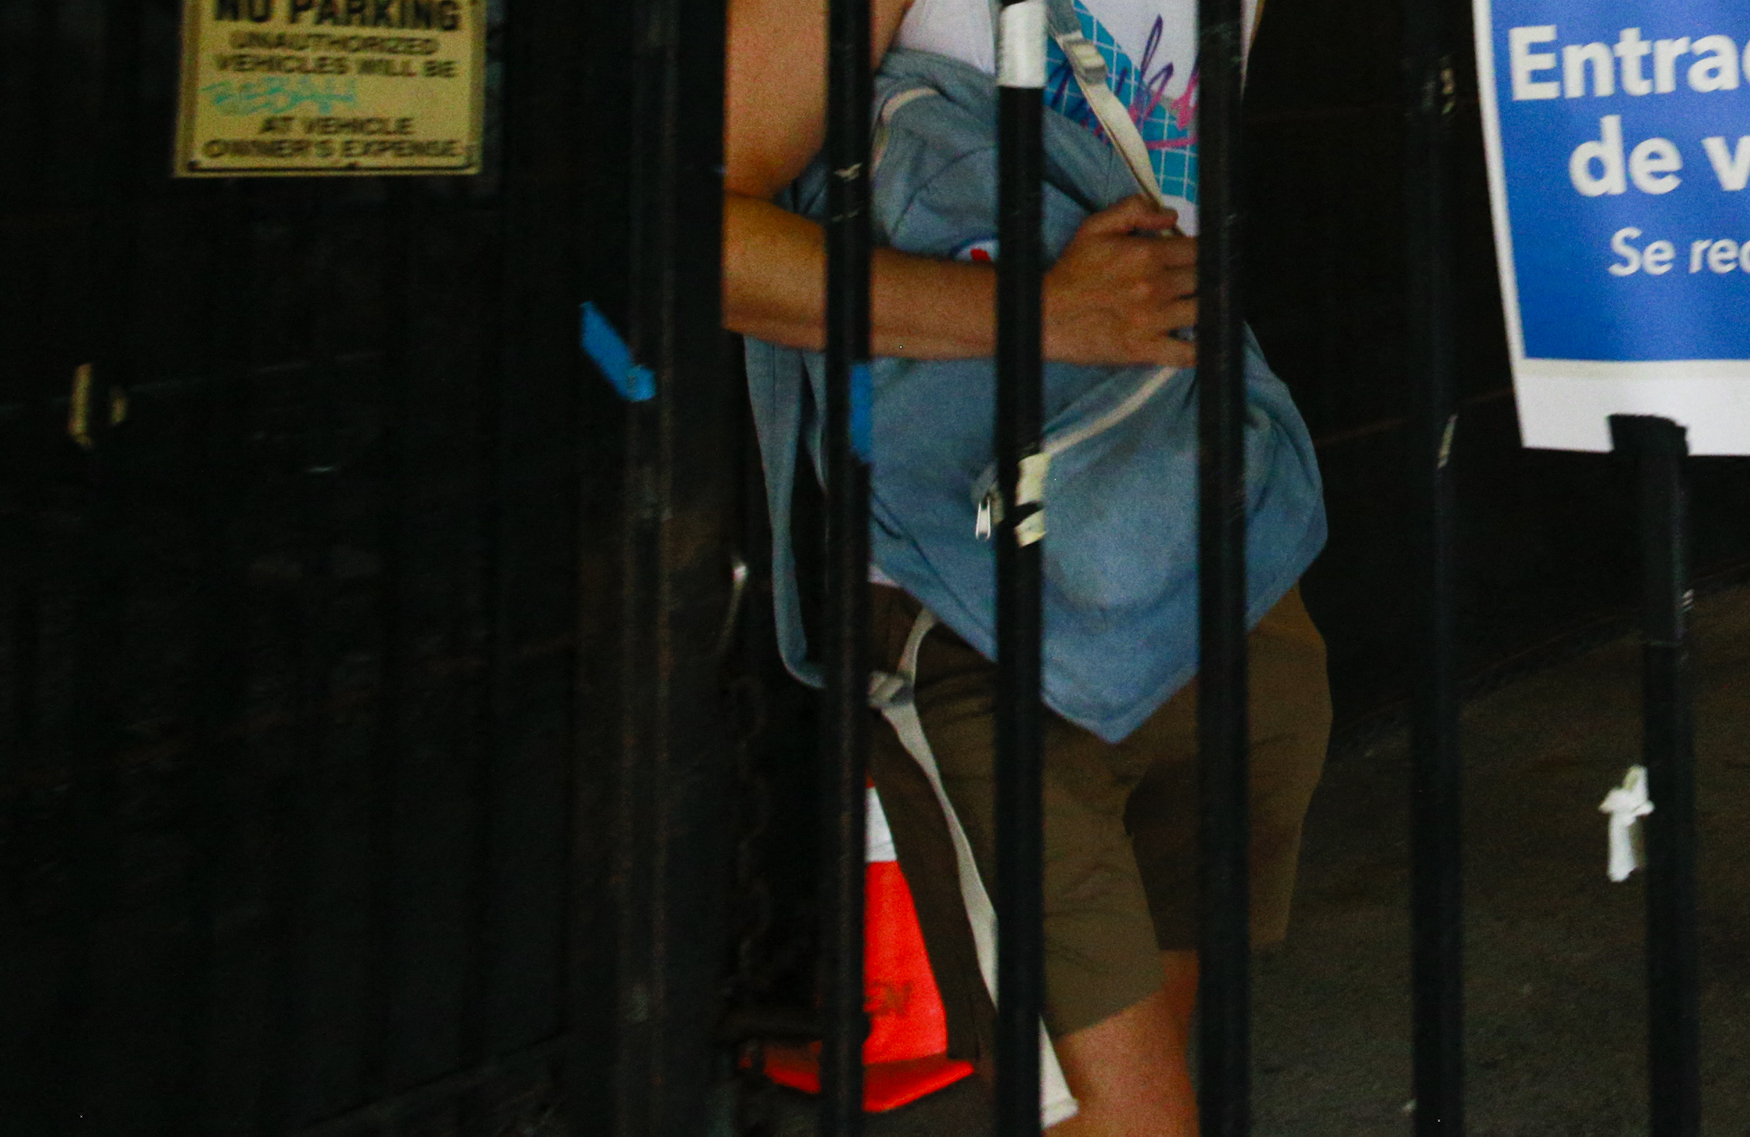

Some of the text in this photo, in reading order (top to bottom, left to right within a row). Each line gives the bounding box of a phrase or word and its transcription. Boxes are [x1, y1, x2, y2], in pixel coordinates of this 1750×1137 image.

[229, 31, 440, 55] UNAUTHORIZED
[214, 54, 456, 78] VEHICLES WILL BE
[260, 116, 414, 136] AT VEHICLE
[1569, 115, 1682, 197] de
[1609, 227, 1676, 276] Se
